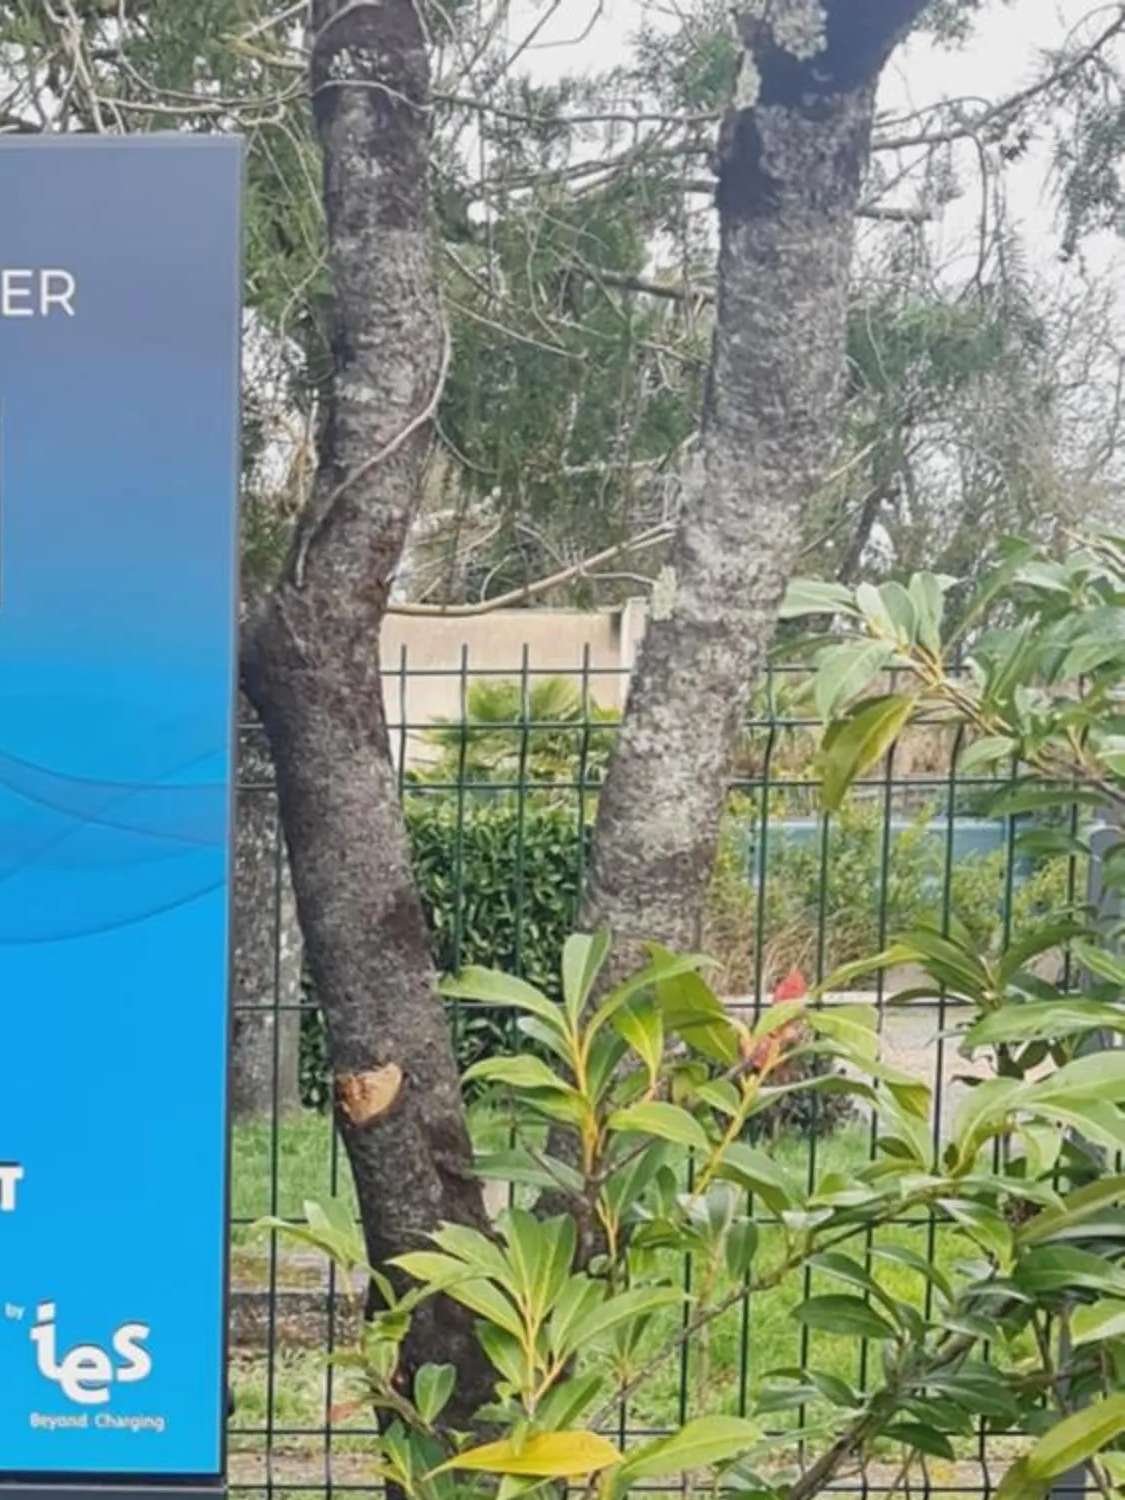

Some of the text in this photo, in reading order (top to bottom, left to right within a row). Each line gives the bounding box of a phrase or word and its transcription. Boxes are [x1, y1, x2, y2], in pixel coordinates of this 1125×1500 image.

[4, 1299, 152, 1405] by ies
[29, 1412, 166, 1433] Beyond Charging
